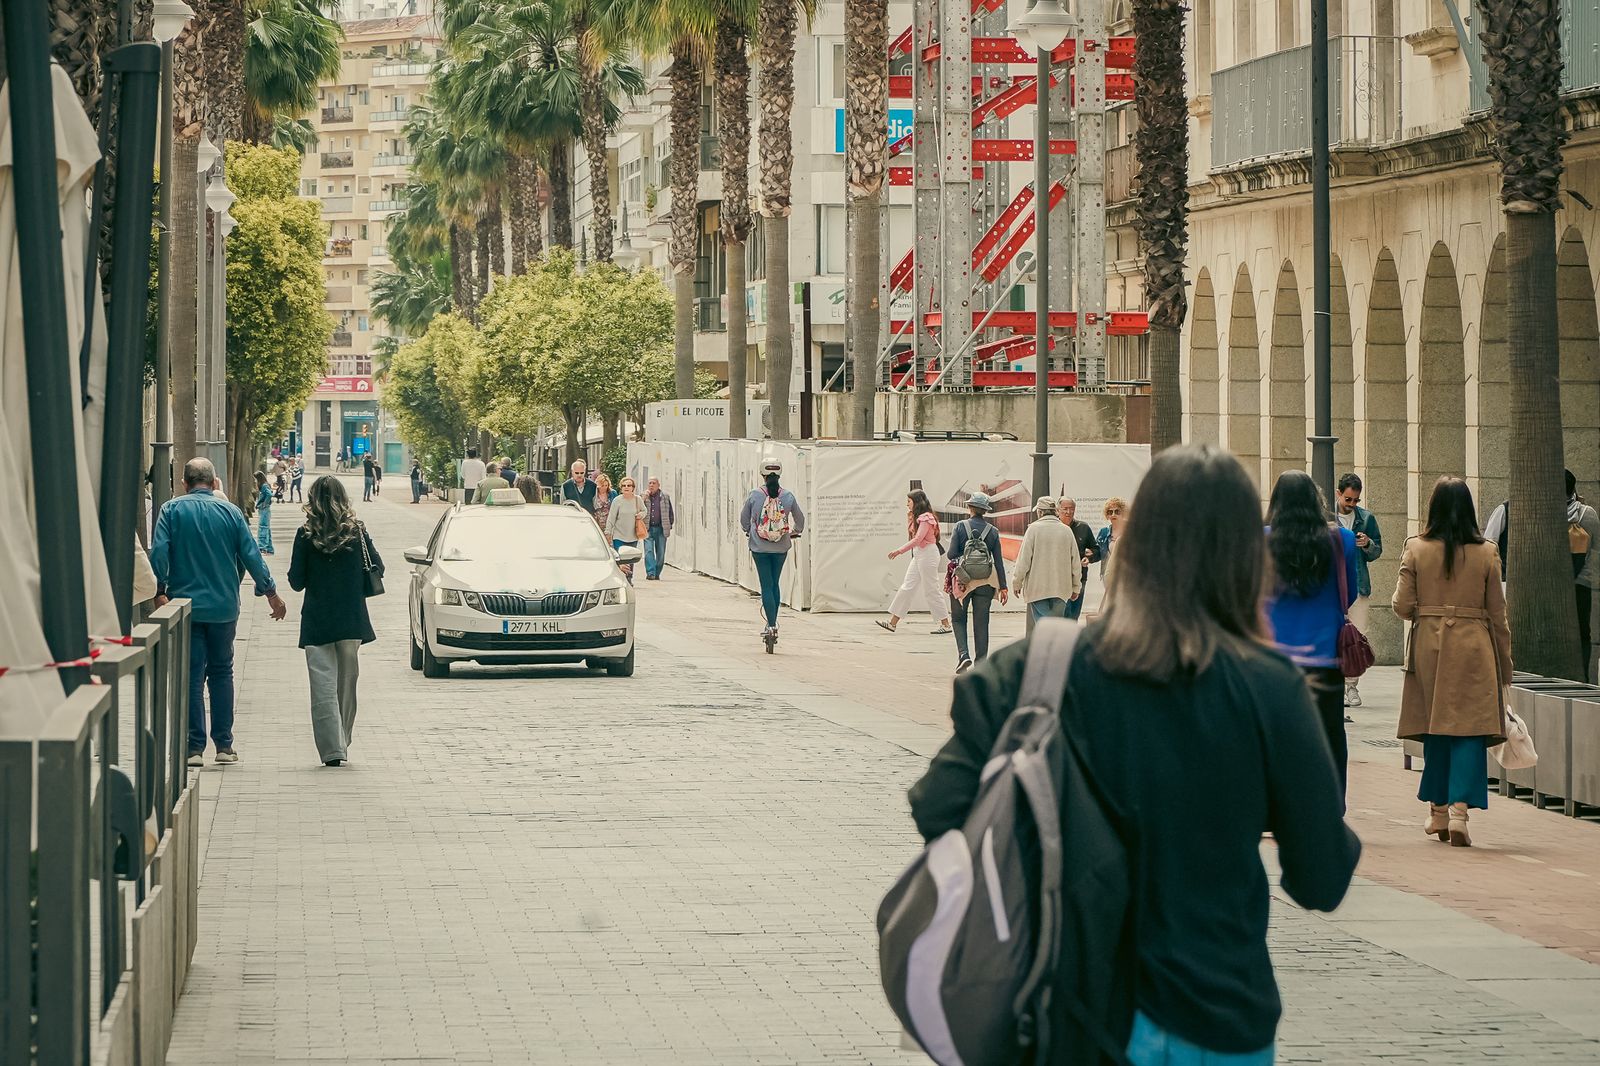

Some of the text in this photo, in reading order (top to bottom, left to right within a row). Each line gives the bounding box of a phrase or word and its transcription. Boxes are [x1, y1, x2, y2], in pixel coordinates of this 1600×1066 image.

[682, 407, 725, 416] EL PICOTE
[511, 622, 563, 633] 2771 KHL
